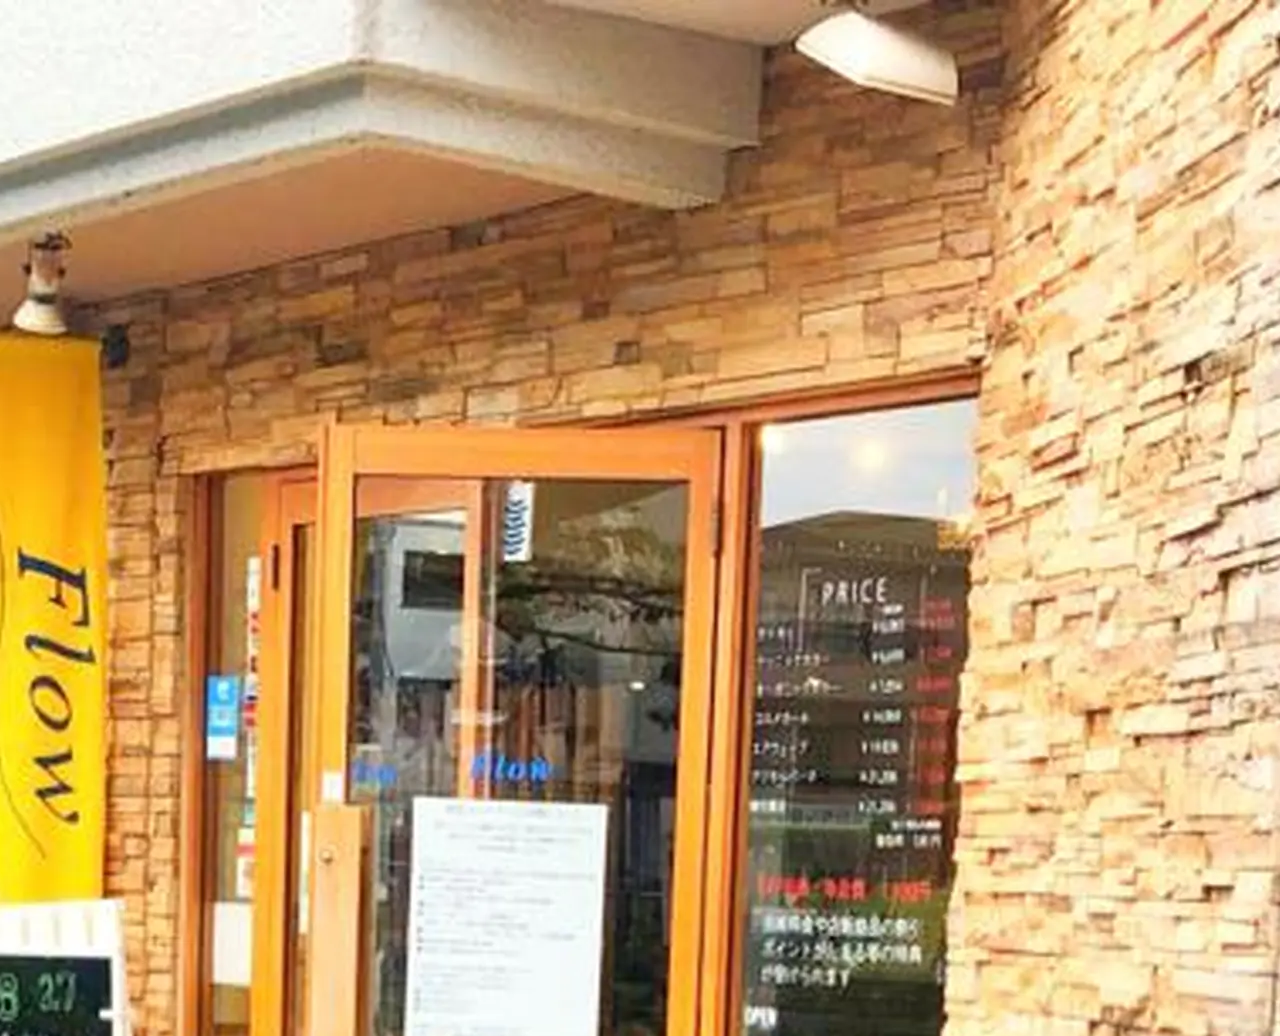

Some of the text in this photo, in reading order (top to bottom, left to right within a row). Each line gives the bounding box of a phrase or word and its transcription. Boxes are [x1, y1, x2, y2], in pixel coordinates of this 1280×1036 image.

[821, 577, 888, 606] PRICE
[18, 547, 96, 825] Flow
[745, 1005, 777, 1030] OPEN
